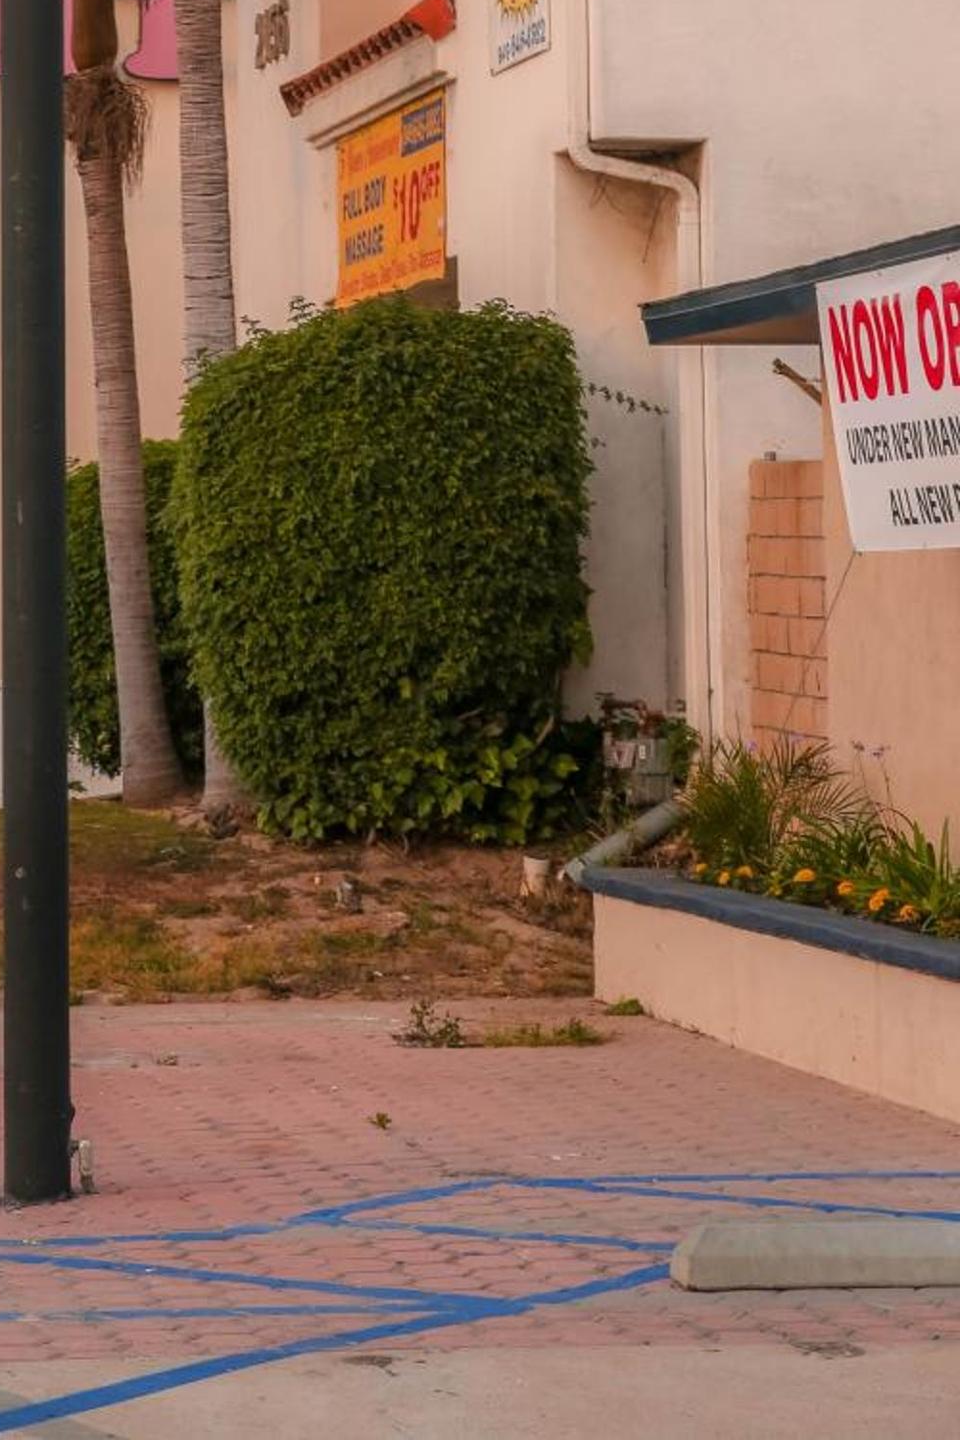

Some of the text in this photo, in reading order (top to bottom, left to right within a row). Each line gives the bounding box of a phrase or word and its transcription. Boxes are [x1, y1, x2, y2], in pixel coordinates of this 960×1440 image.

[828, 292, 909, 404] NOW
[846, 424, 893, 465] UNDER
[890, 420, 924, 461] NEW
[889, 487, 919, 527] ALL
[915, 483, 954, 525] NEW
